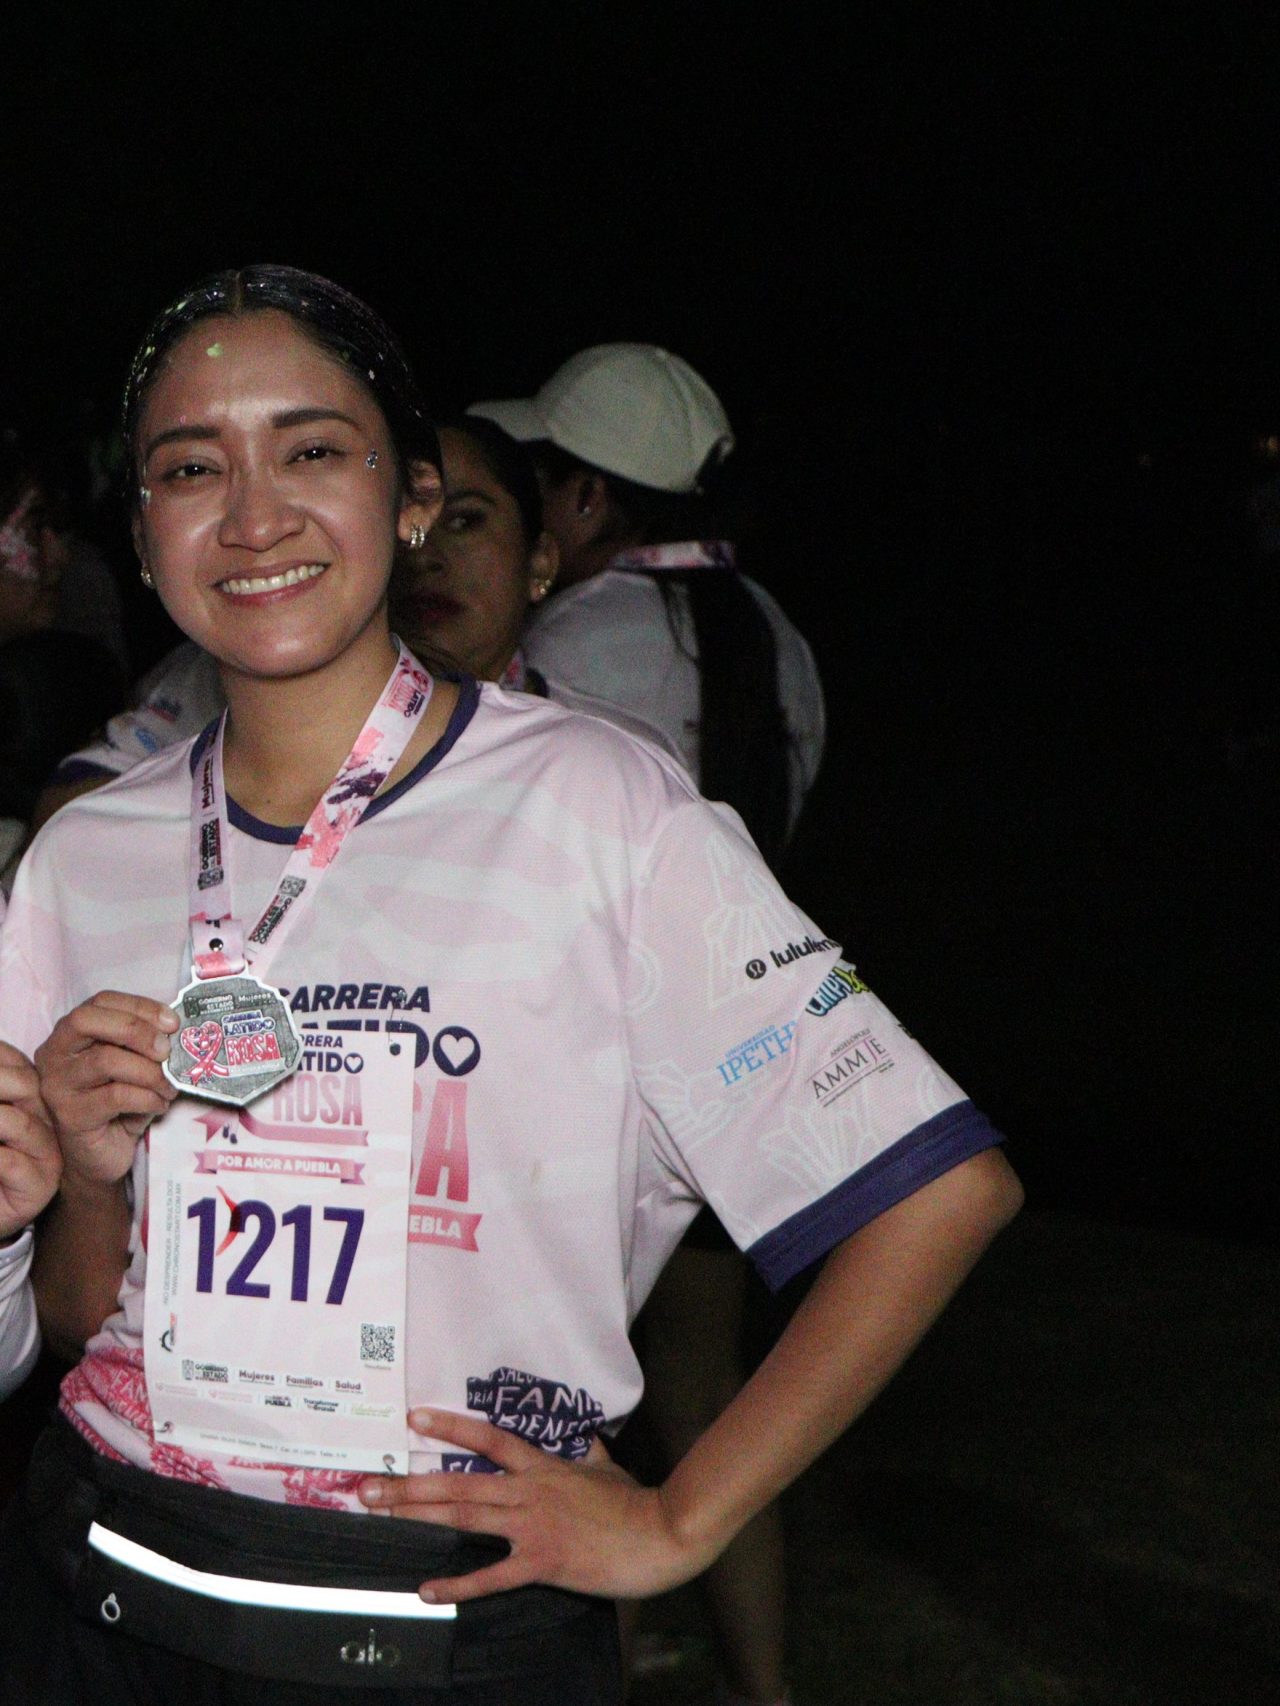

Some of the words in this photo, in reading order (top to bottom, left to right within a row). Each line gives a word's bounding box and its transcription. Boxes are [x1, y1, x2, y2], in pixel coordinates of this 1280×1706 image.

[225, 1031, 281, 1067] ROSA
[299, 1034, 343, 1048] RERA
[297, 1051, 364, 1074] TIDO
[273, 1073, 363, 1126] ROSA
[217, 1155, 243, 1167] POR
[245, 1157, 282, 1170] AMOR
[282, 1161, 293, 1171] A
[294, 1162, 342, 1175] PUEBLA
[410, 1214, 462, 1239] EBLA
[187, 1197, 365, 1305] 1217
[239, 1370, 275, 1384] Mujeres
[286, 1375, 324, 1388] Familias
[335, 1380, 361, 1391] Salud
